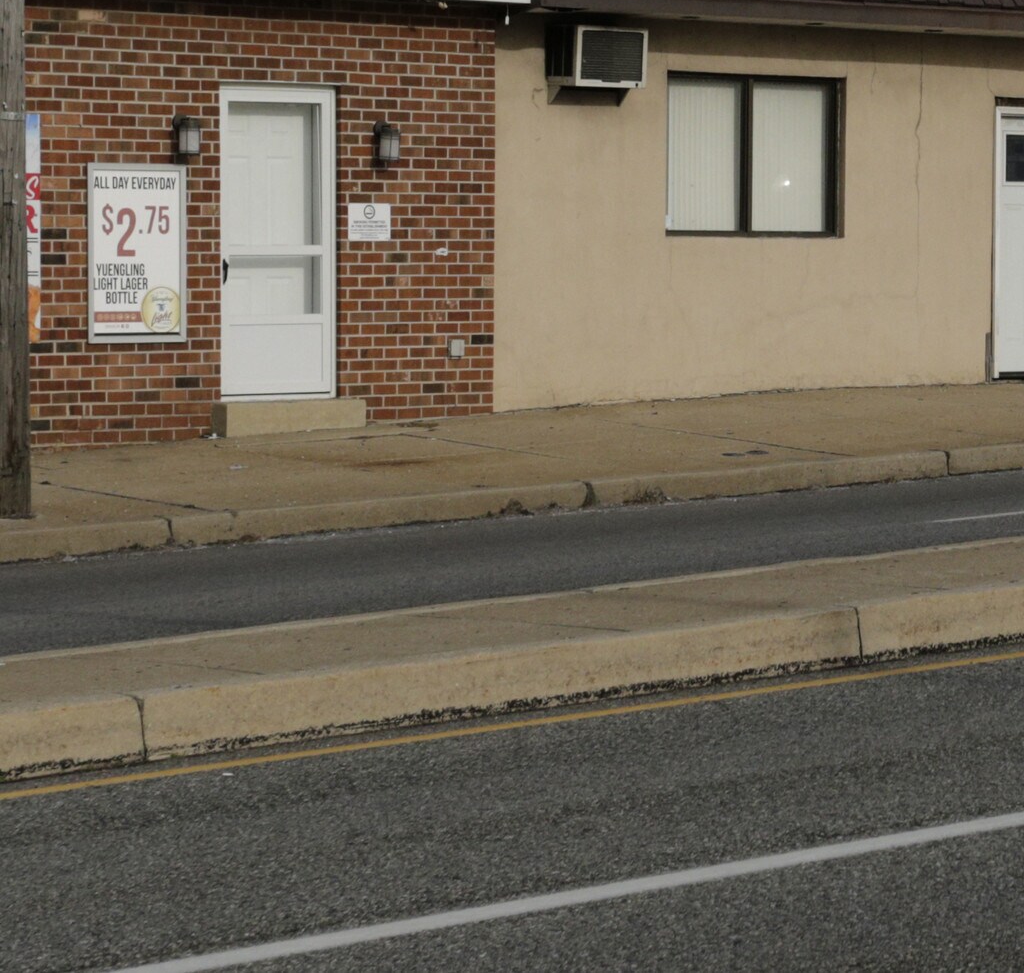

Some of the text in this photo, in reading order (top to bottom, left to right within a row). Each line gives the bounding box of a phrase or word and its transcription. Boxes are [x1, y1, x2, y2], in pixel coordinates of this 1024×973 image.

[94, 176, 176, 190] ALL DAY EVERYDAY
[96, 263, 145, 277] YUENGLING
[93, 277, 148, 290] LIGHT LAGER
[105, 291, 138, 304] BOTTLE
